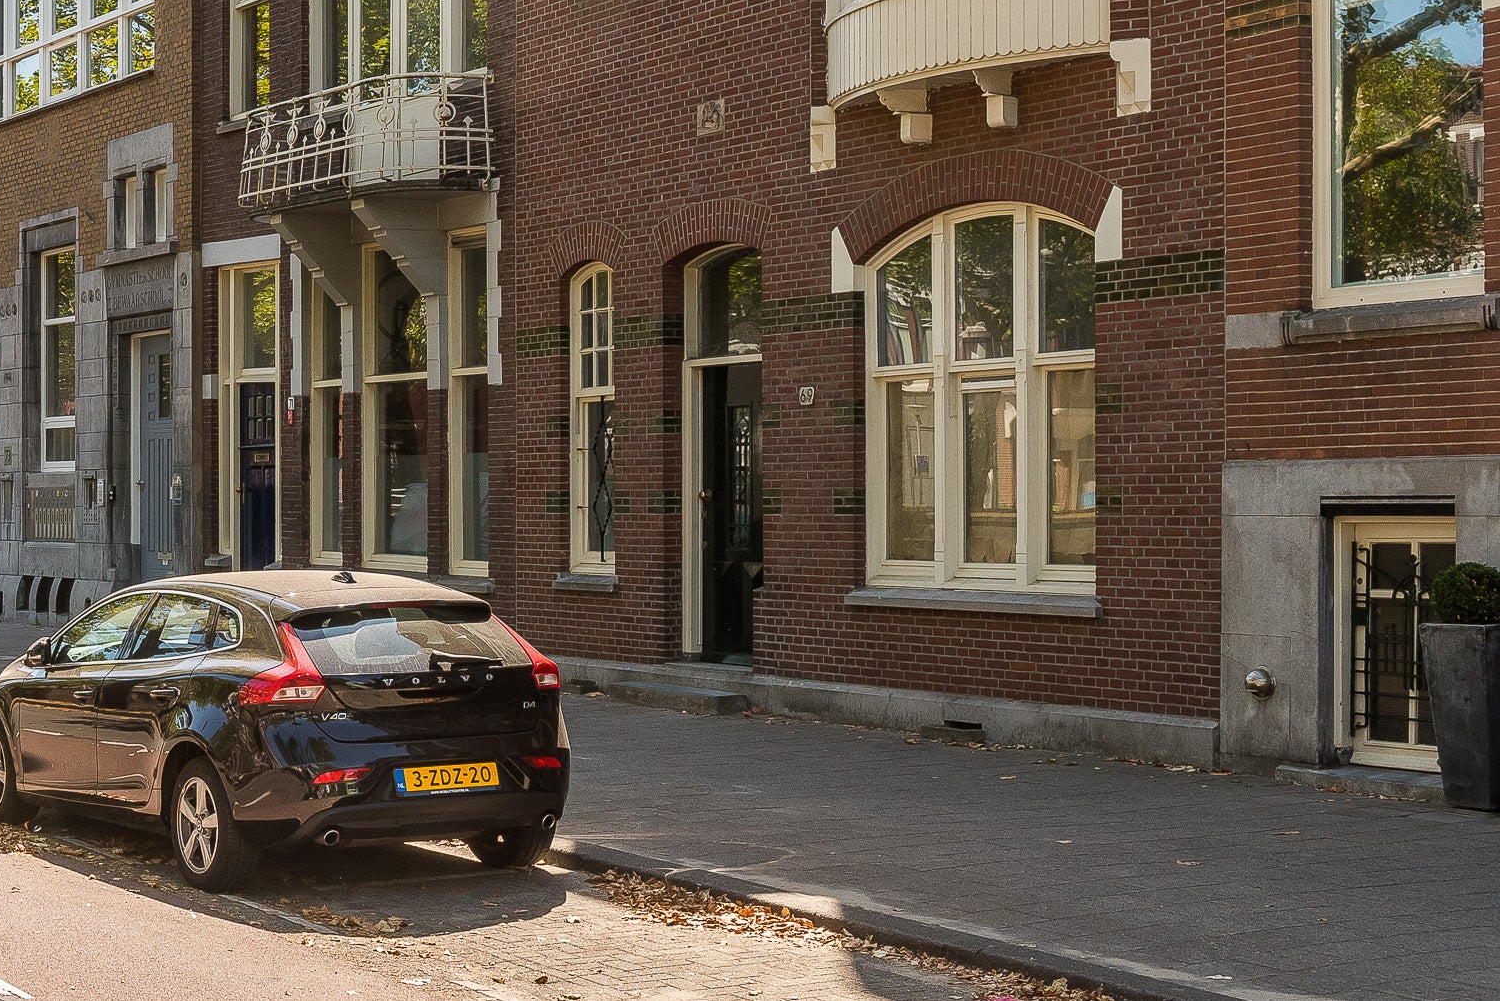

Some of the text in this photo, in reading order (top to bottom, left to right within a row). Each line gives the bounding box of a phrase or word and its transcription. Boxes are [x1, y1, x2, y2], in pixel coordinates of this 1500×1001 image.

[800, 388, 813, 403] 69
[382, 673, 494, 686] VOLVO
[523, 701, 536, 709] D4
[321, 712, 347, 721] V40
[412, 766, 491, 788] 3-ZDZ-20
